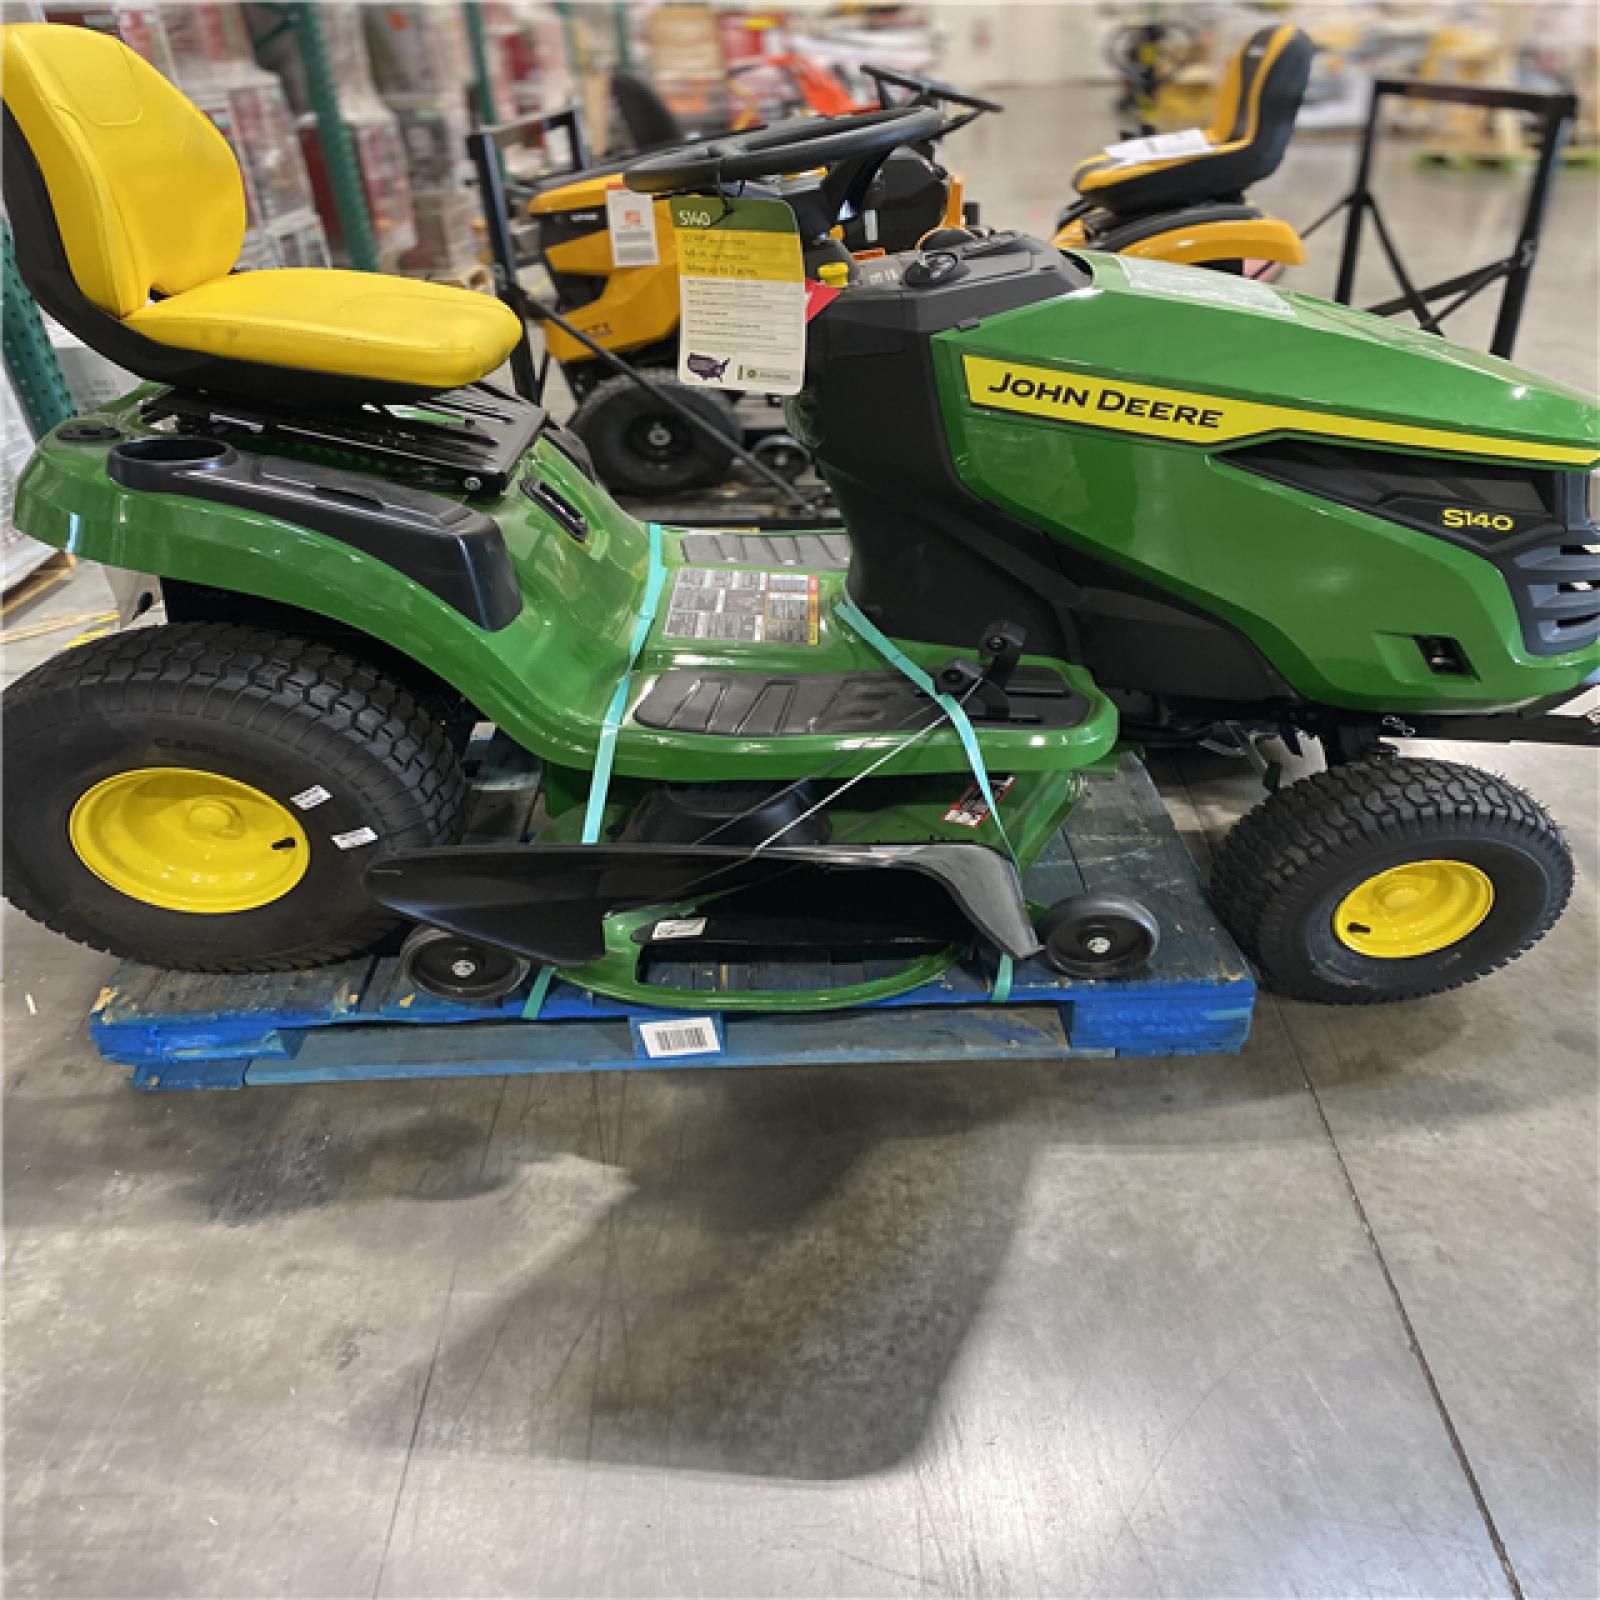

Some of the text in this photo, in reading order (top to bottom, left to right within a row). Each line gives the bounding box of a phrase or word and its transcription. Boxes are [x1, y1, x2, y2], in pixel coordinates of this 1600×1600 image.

[988, 372, 1224, 428] JOHN DEERE
[1442, 508, 1514, 531] S140
